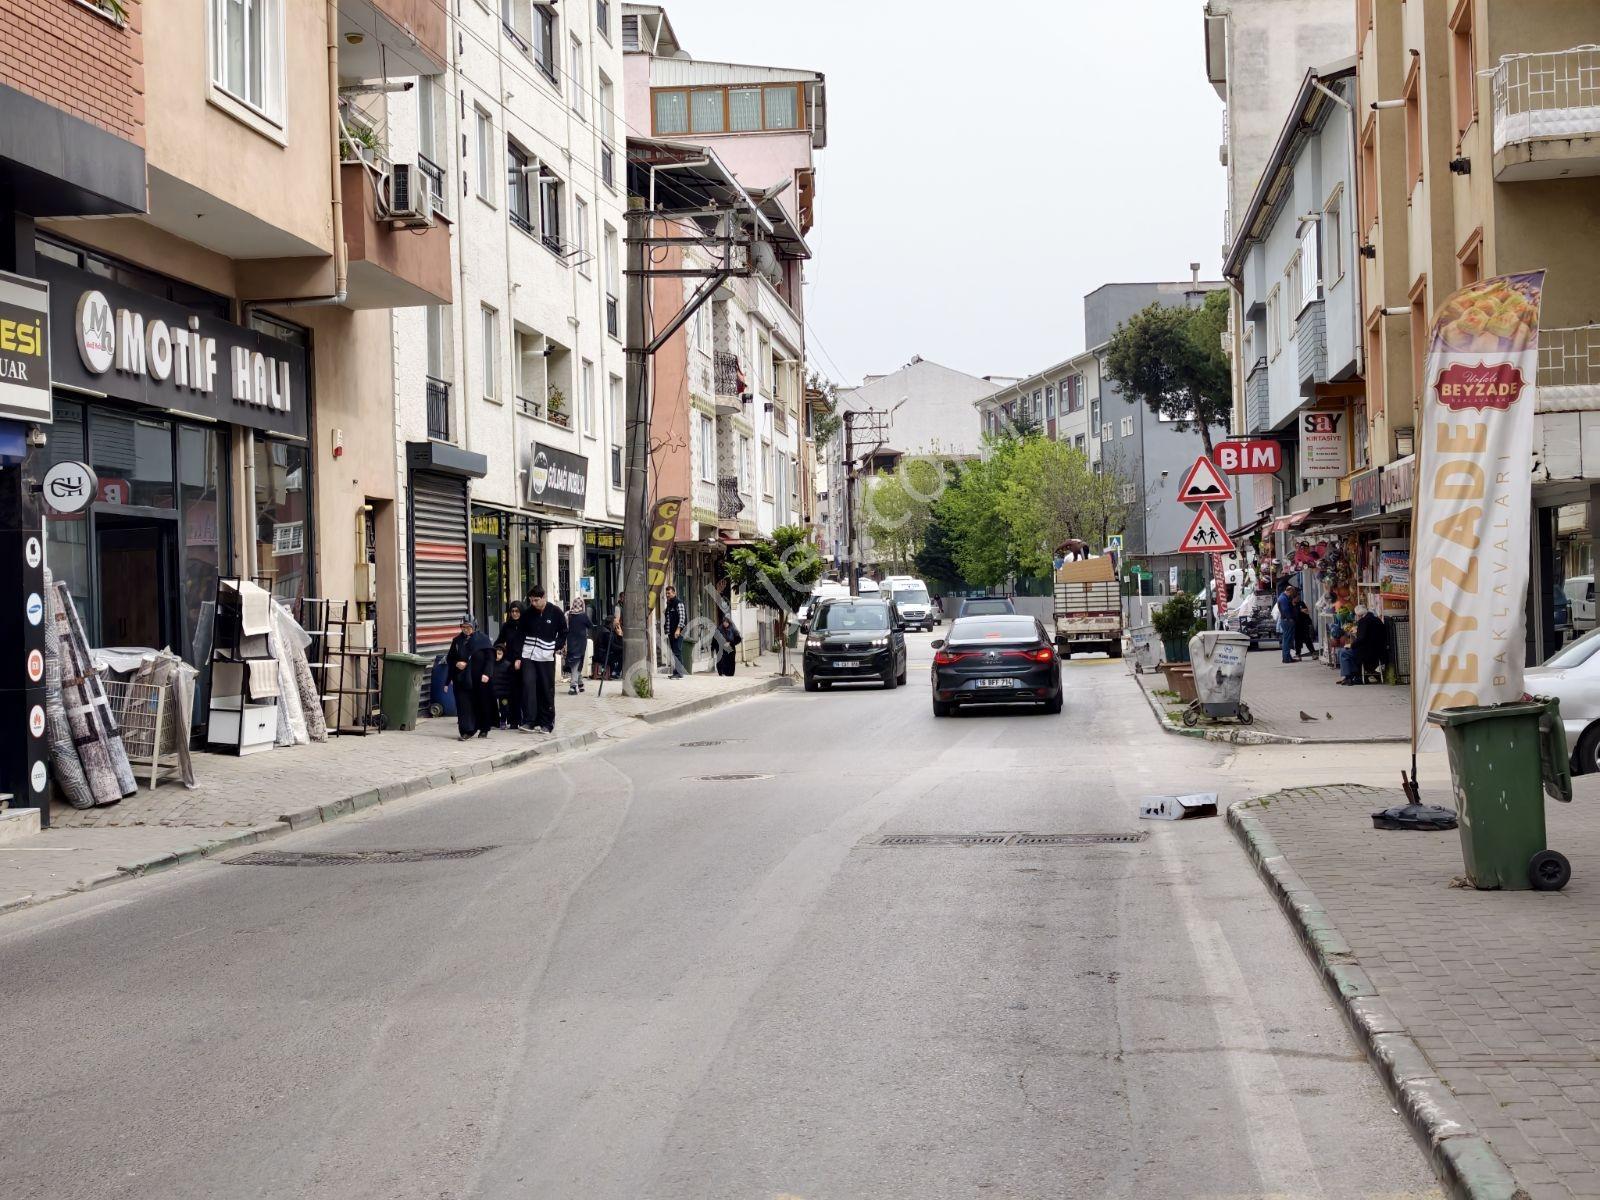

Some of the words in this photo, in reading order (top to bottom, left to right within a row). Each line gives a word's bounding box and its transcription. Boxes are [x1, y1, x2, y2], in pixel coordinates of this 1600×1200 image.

[231, 345, 291, 412] HALI
[1441, 382, 1518, 397] BEYZADE
[1220, 442, 1276, 471] BİM
[1493, 454, 1512, 687] BAKLAVALARI
